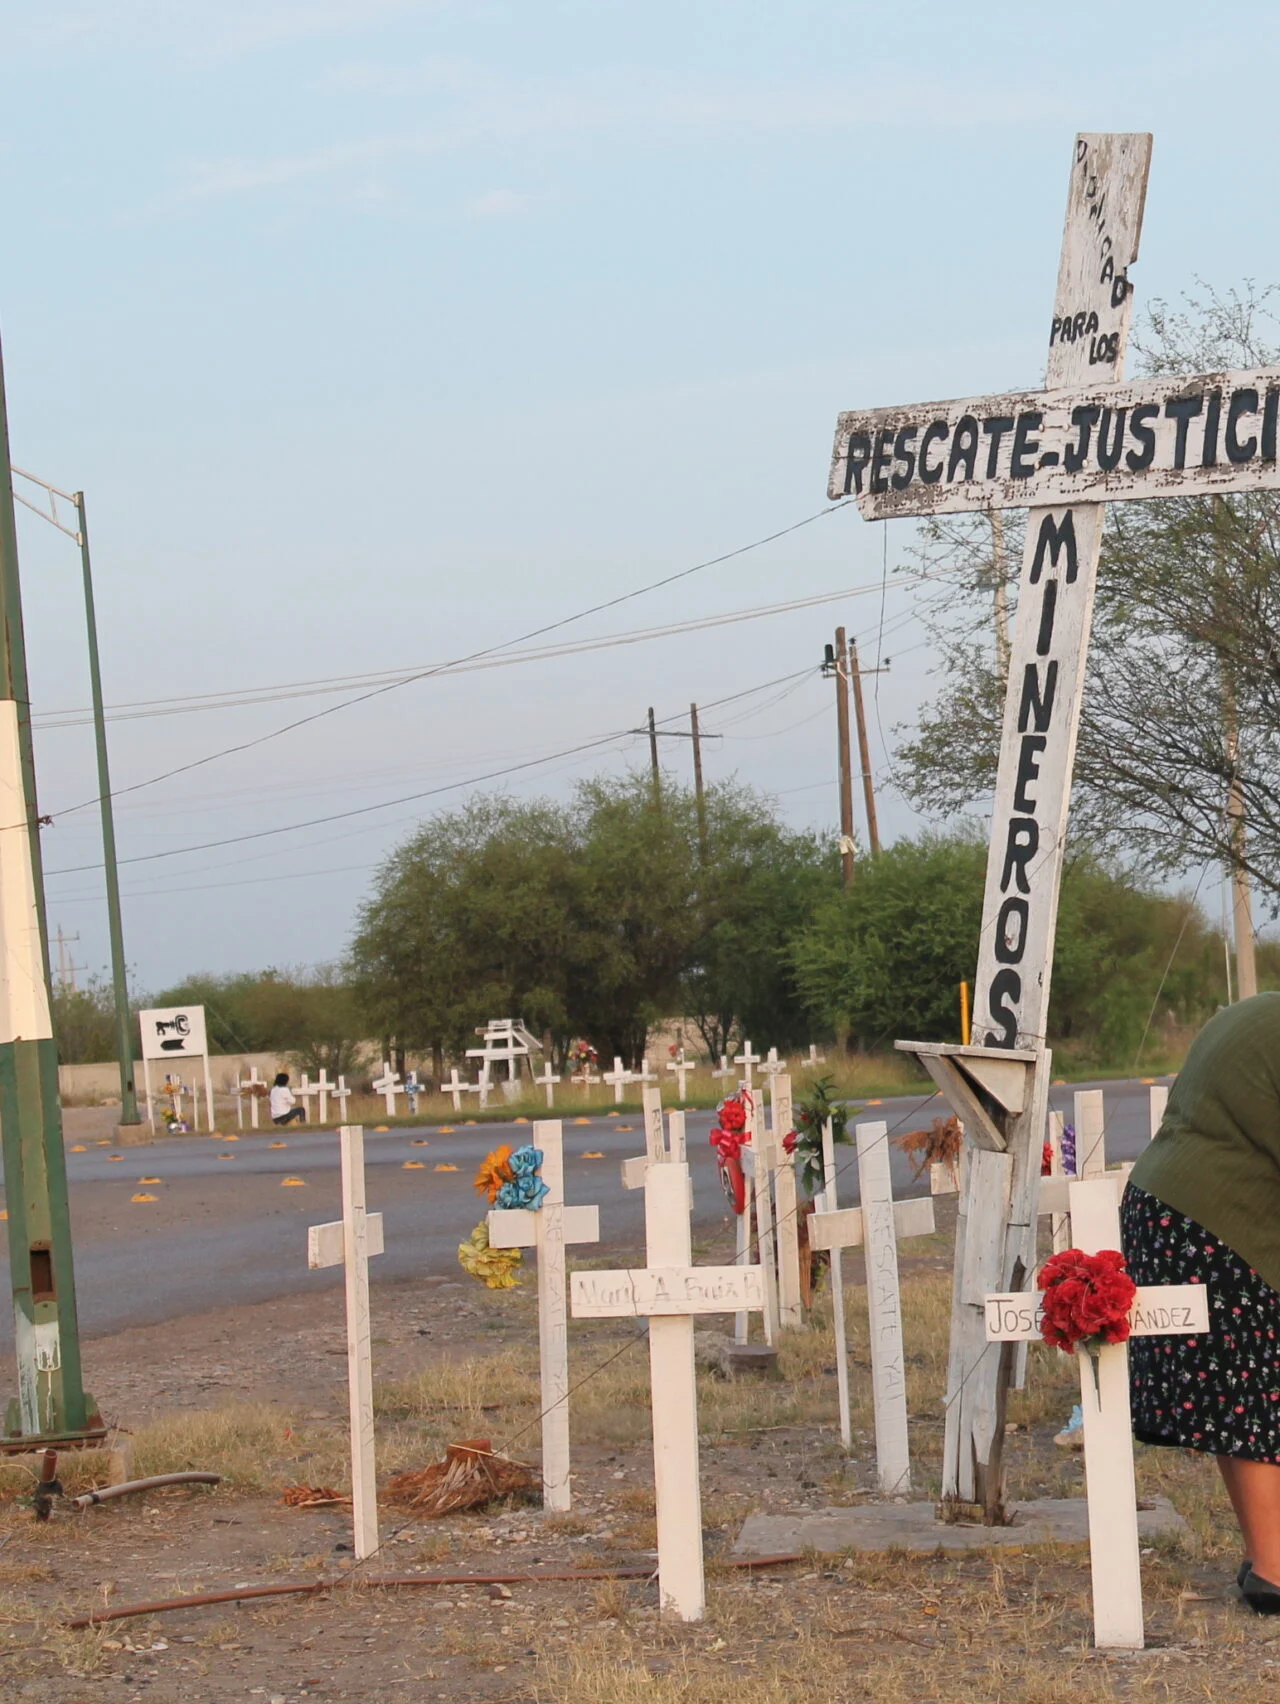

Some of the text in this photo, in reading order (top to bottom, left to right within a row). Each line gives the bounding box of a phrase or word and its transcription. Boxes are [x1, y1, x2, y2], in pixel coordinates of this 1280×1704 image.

[1050, 311, 1098, 347] PARA
[1089, 332, 1120, 365] LOS
[984, 508, 1078, 1050] MINEROS
